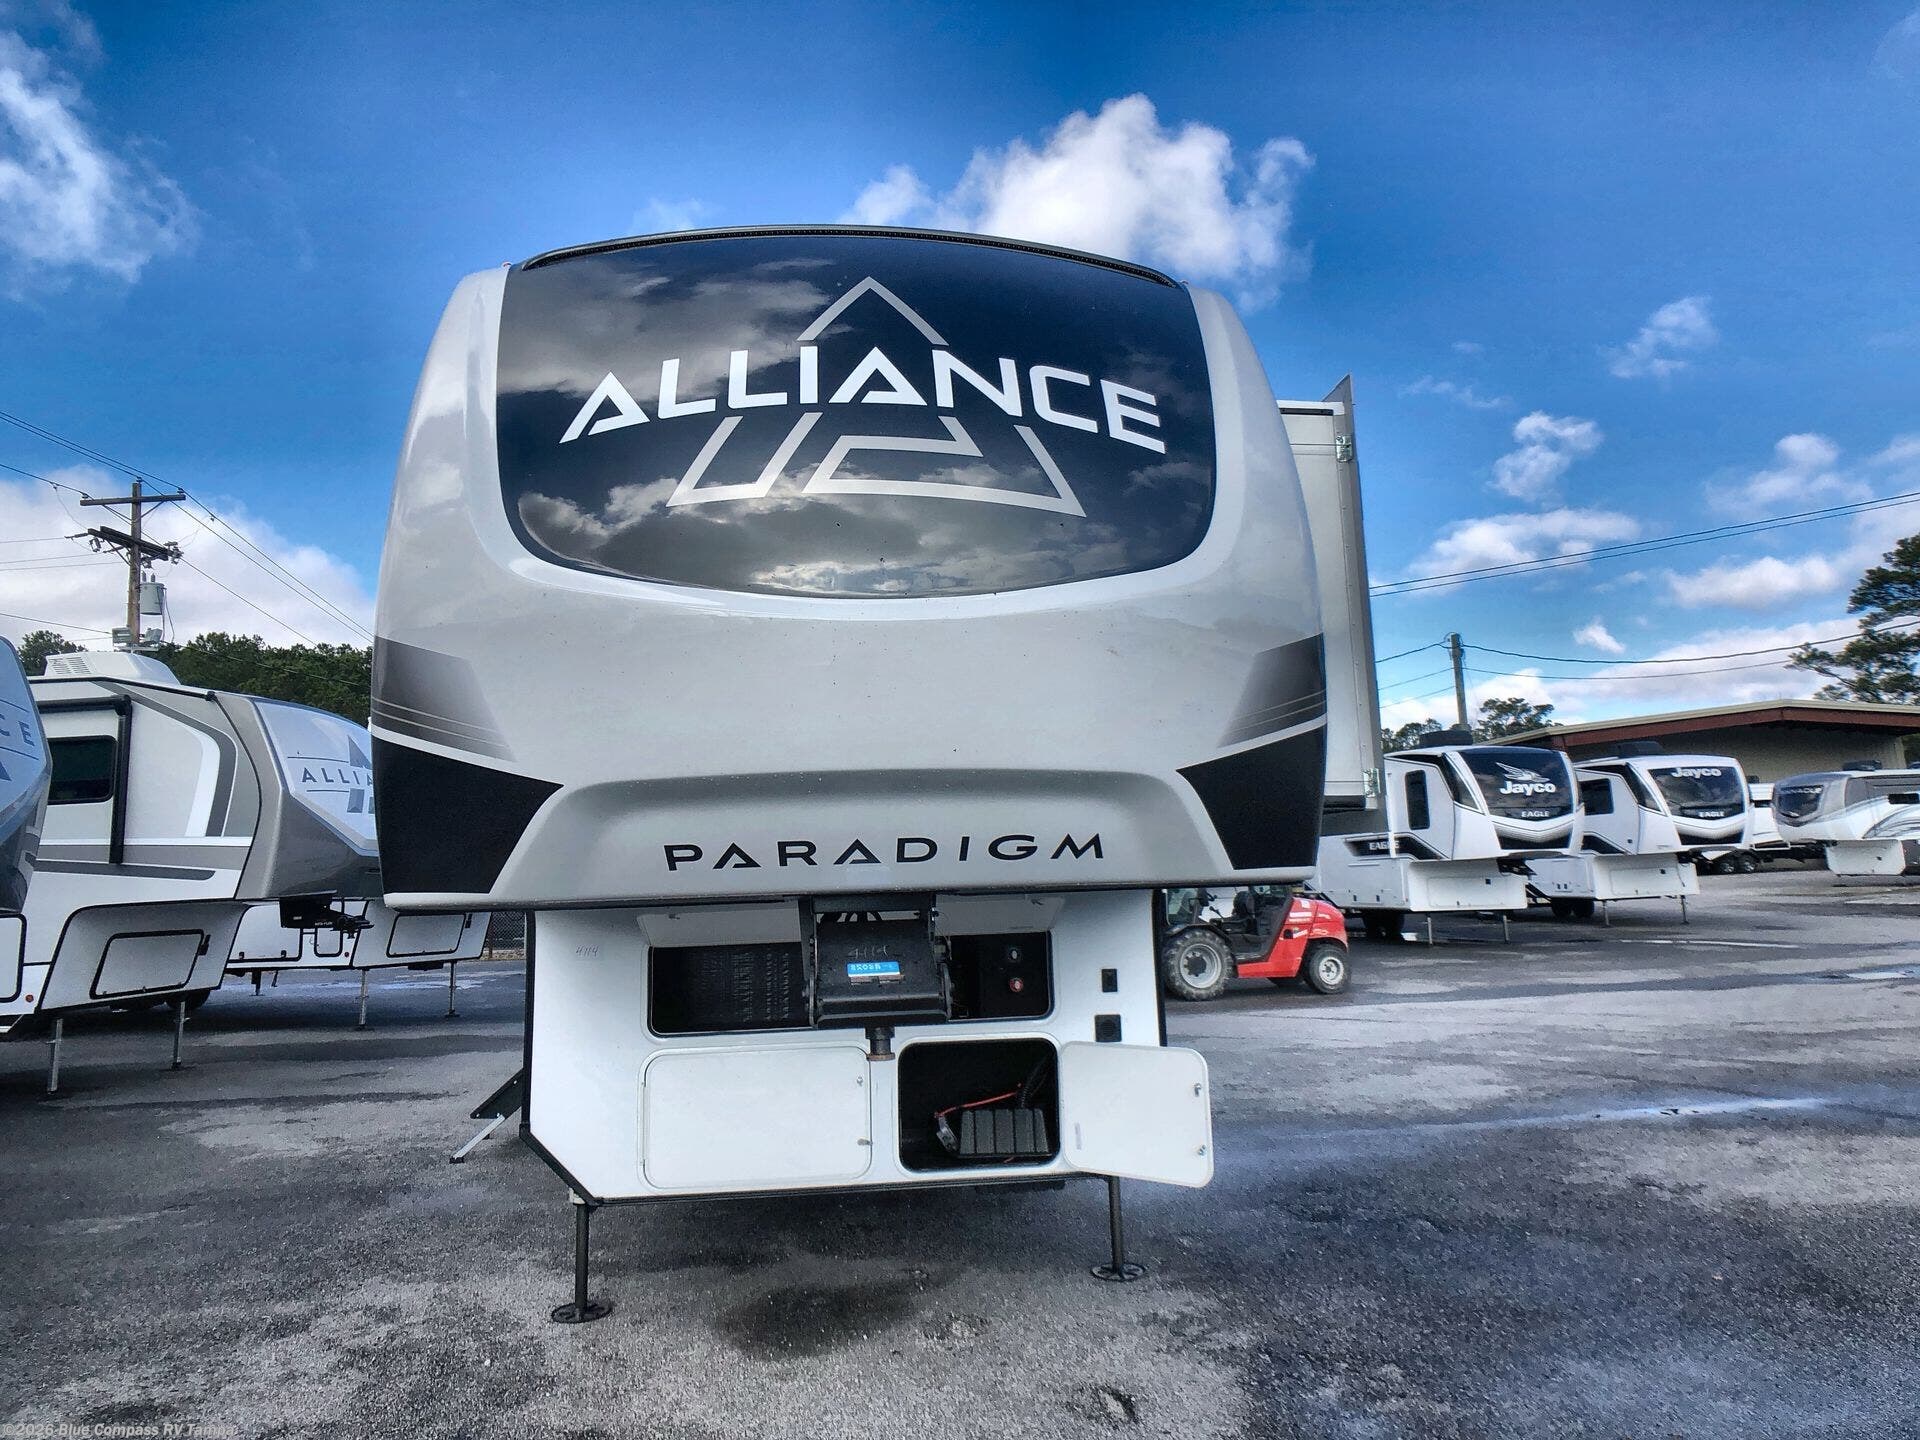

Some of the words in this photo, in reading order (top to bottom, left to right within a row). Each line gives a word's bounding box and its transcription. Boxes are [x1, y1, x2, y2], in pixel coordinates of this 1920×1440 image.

[559, 345, 1166, 454] ALLIANCE
[1671, 766, 1722, 779] Jayco
[1500, 780, 1556, 796] Jayco
[1521, 810, 1550, 818] EAGLE
[664, 833, 1104, 872] PARADIGM
[1369, 840, 1400, 851] EAGE
